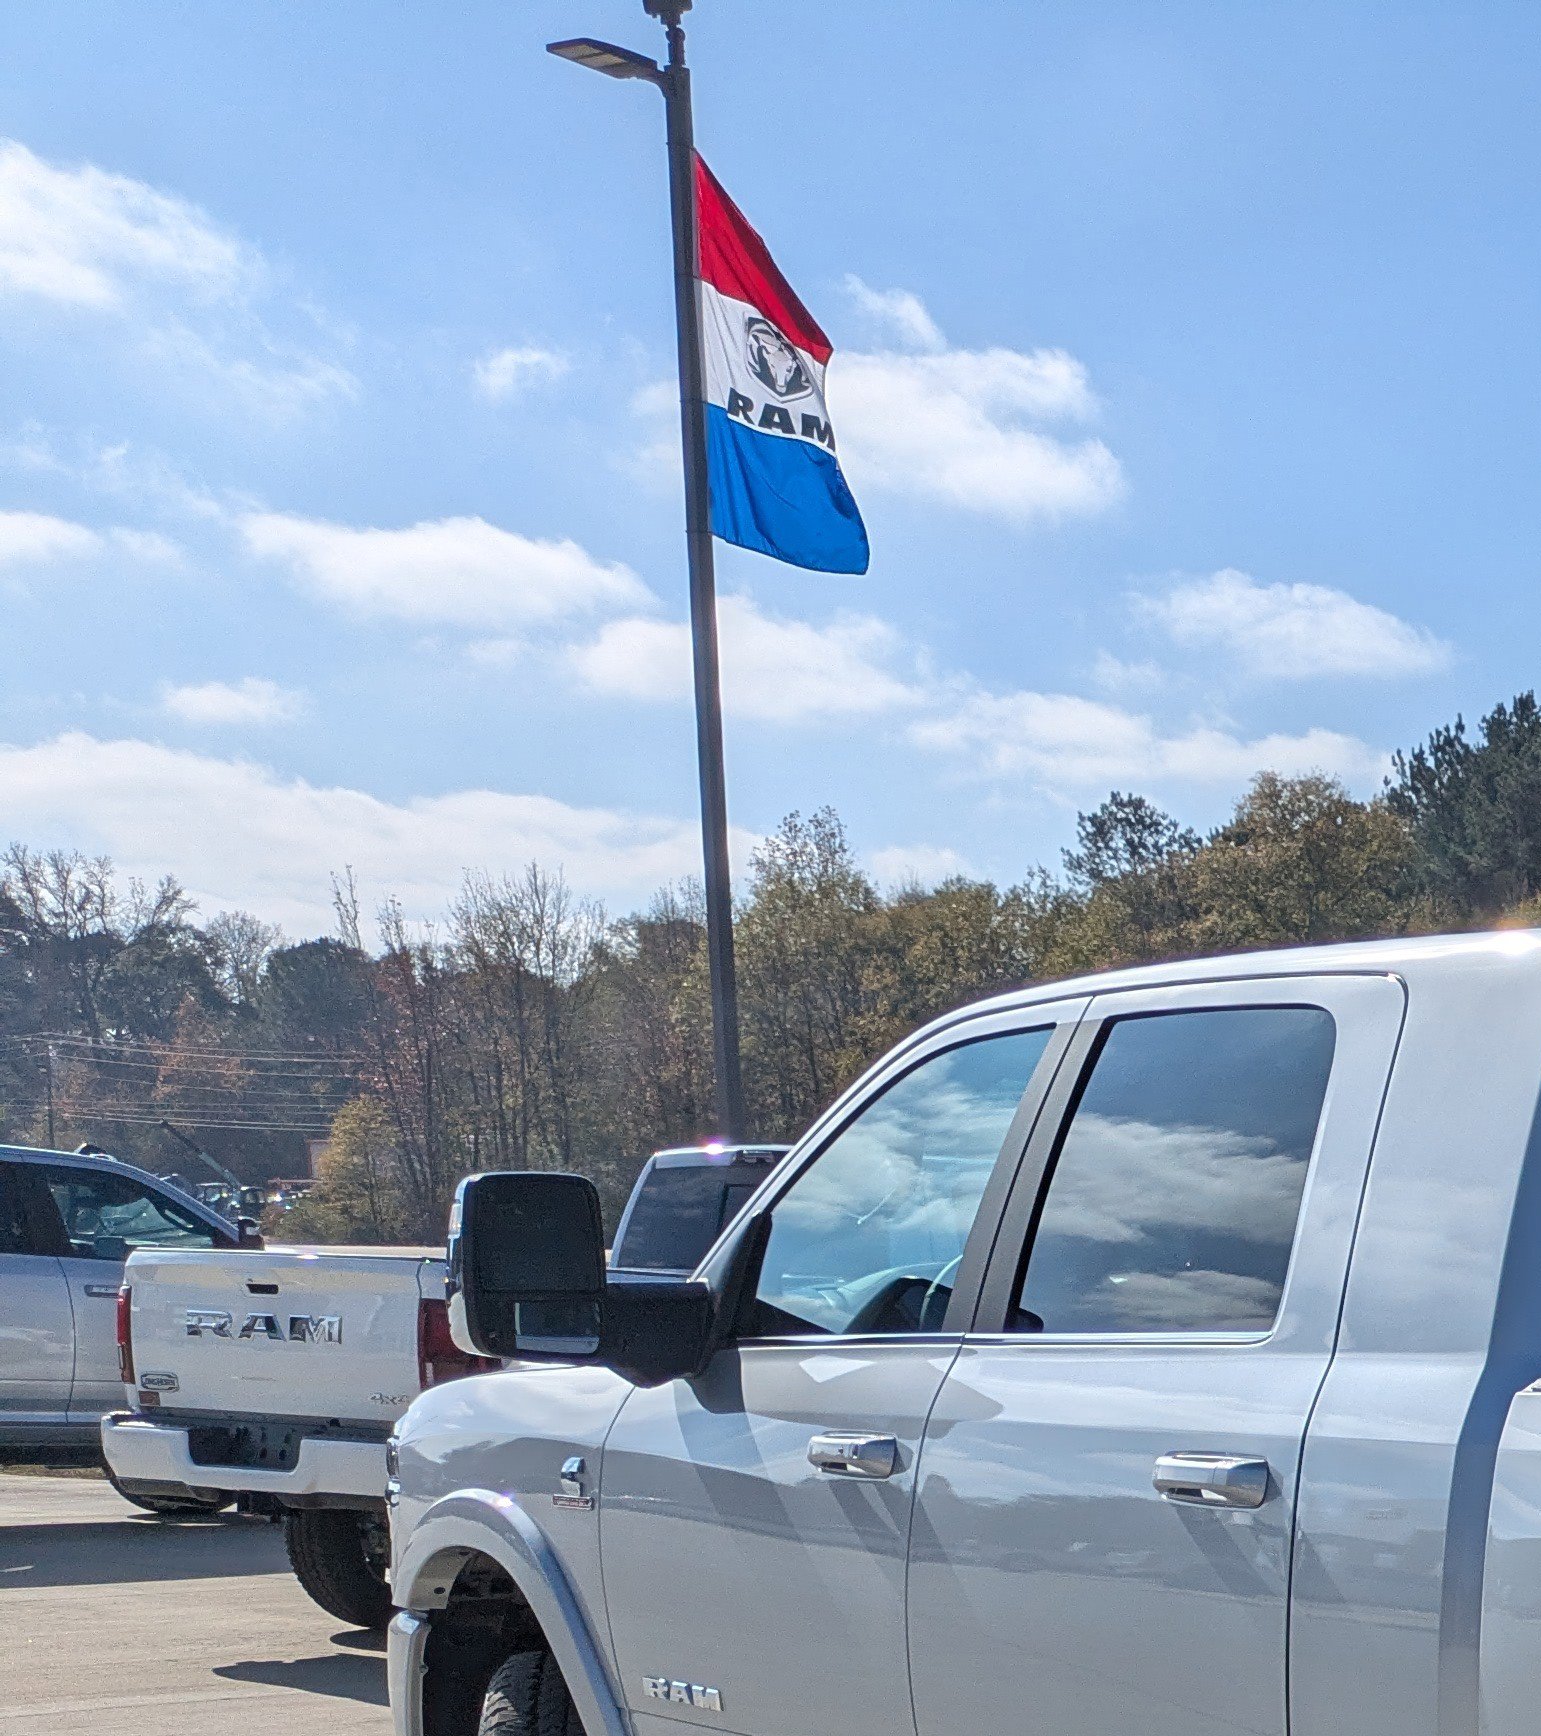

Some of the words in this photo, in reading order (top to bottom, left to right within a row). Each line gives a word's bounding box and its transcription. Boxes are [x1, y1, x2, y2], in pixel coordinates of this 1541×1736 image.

[727, 387, 836, 452] RAM
[186, 1308, 343, 1345] RAM
[641, 1676, 725, 1712] RAM
